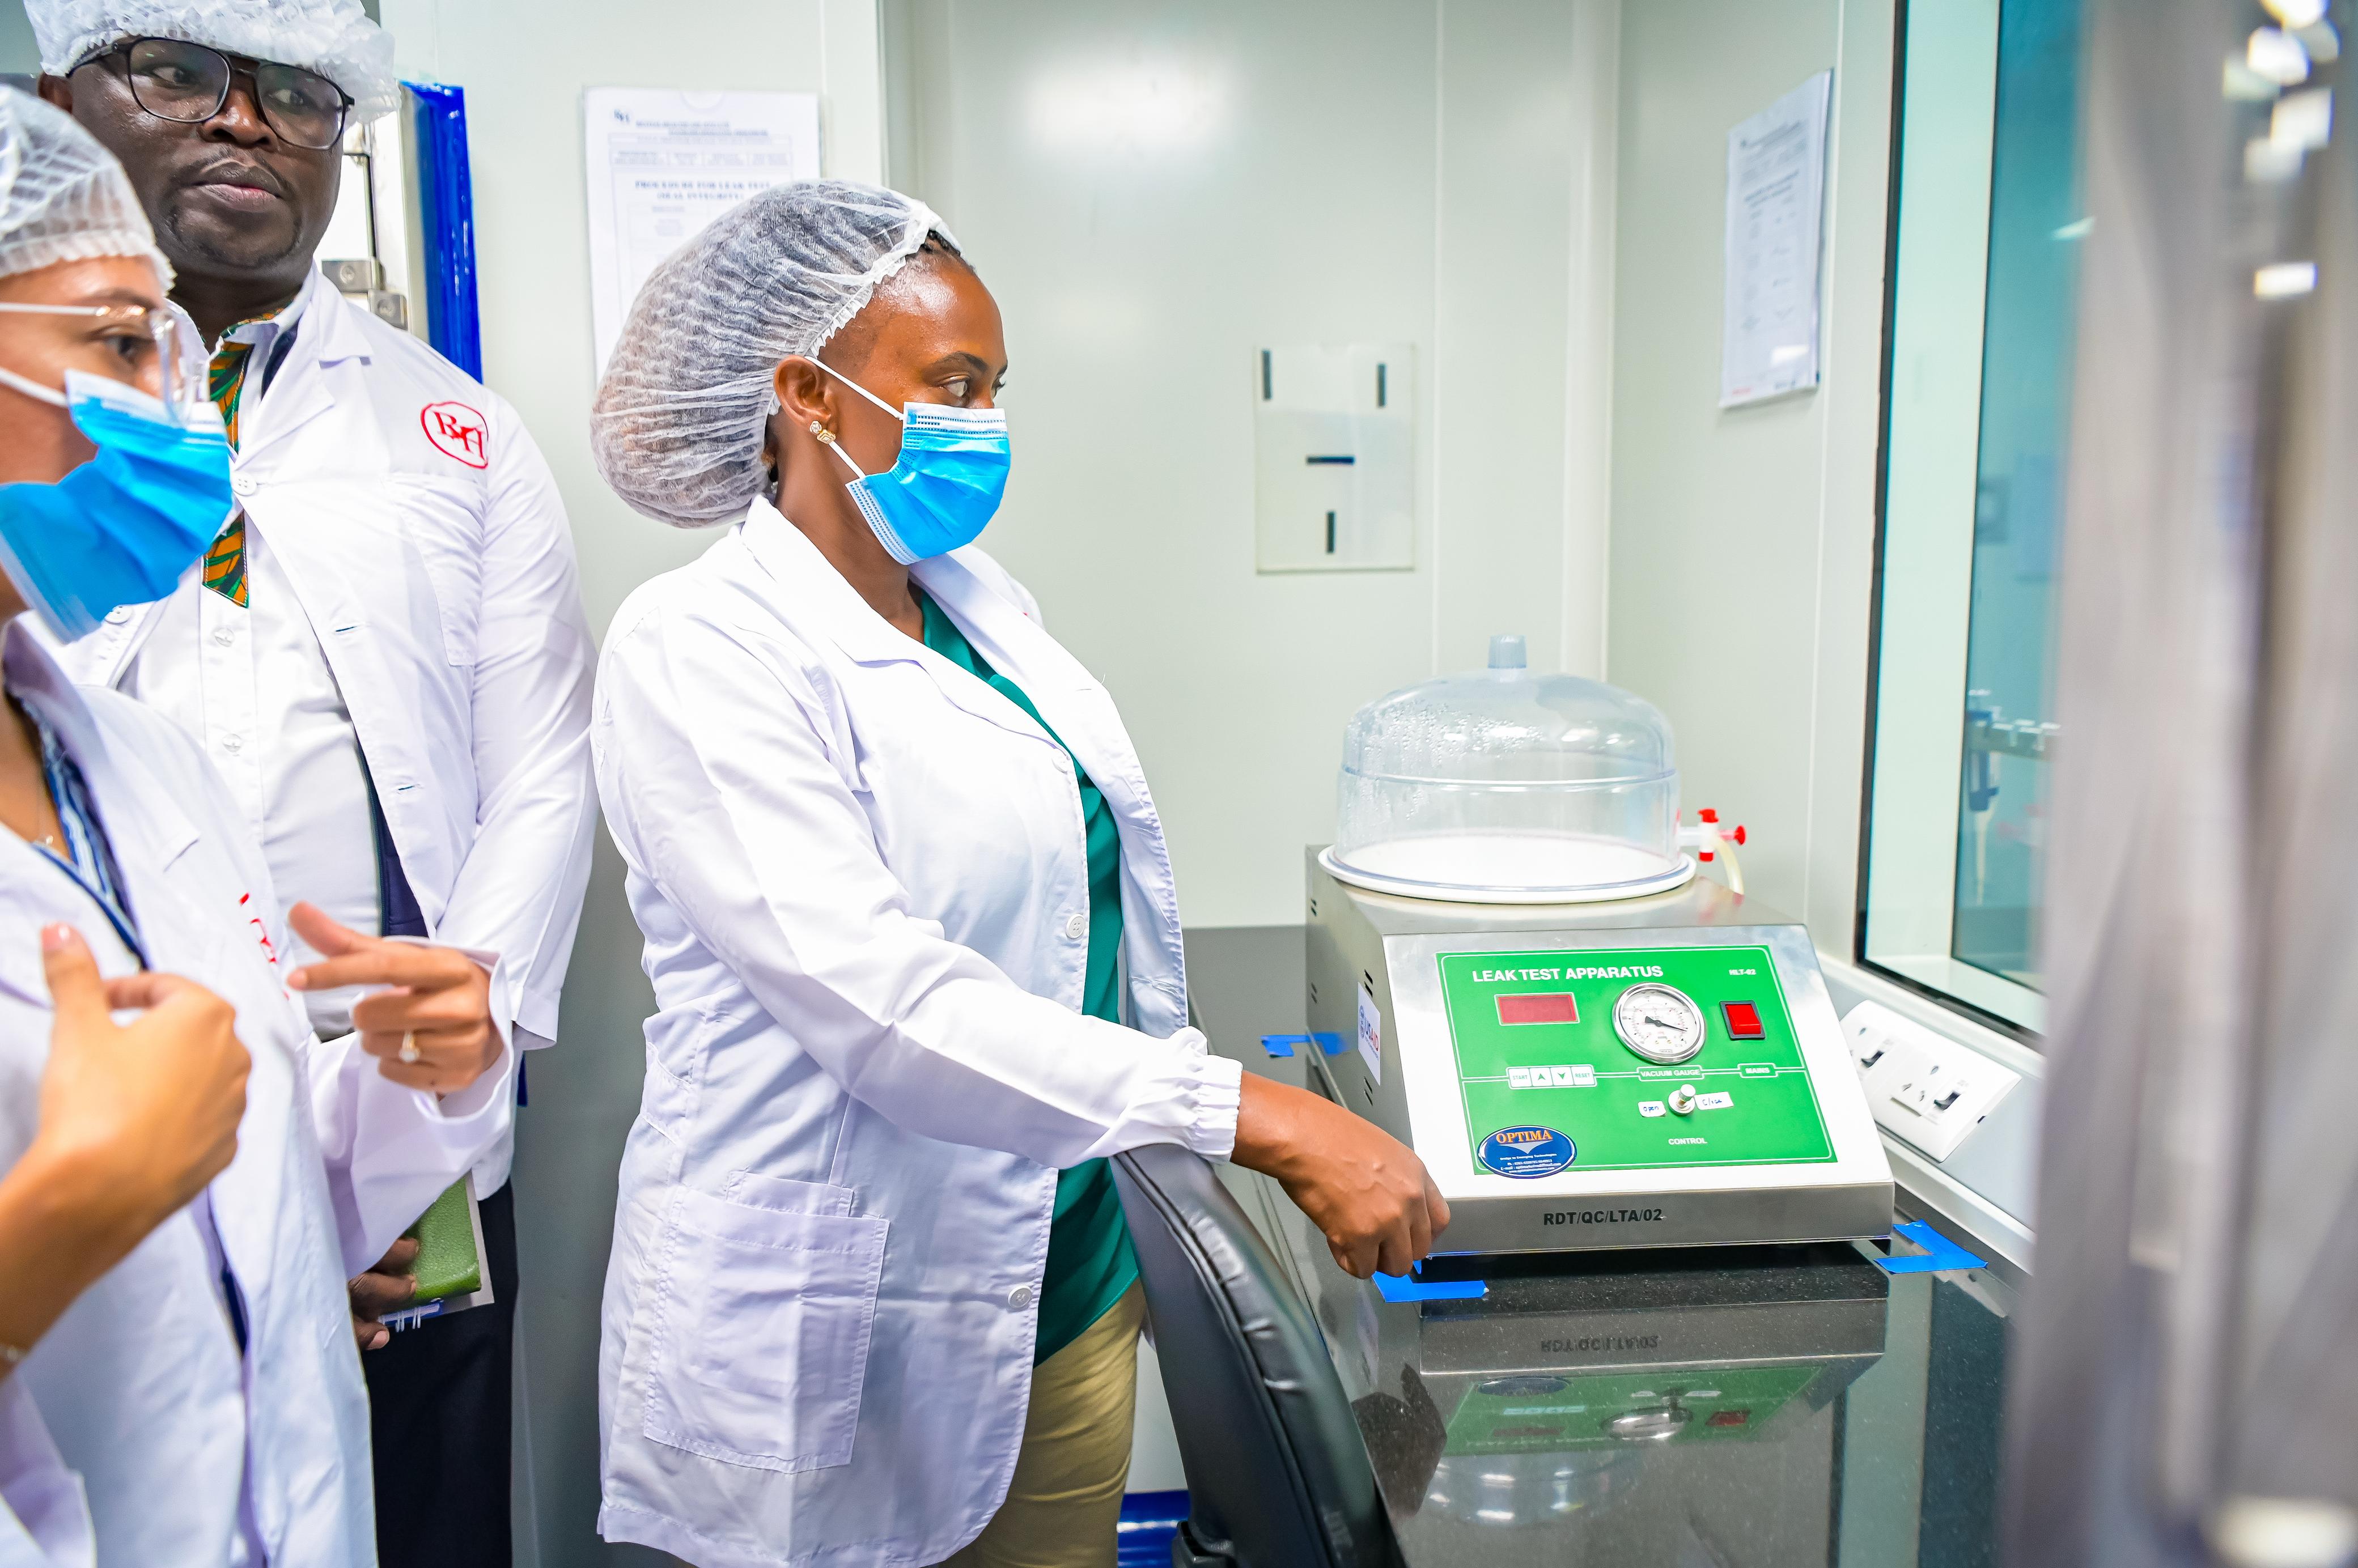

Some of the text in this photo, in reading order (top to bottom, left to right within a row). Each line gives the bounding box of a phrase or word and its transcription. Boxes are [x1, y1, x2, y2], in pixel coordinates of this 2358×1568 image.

[1472, 965, 1664, 982] LEAK TEST APPARATUS
[1496, 1129, 1553, 1144] OPTIMA
[1543, 1208, 1663, 1225] RDT/QC/LTA/02
